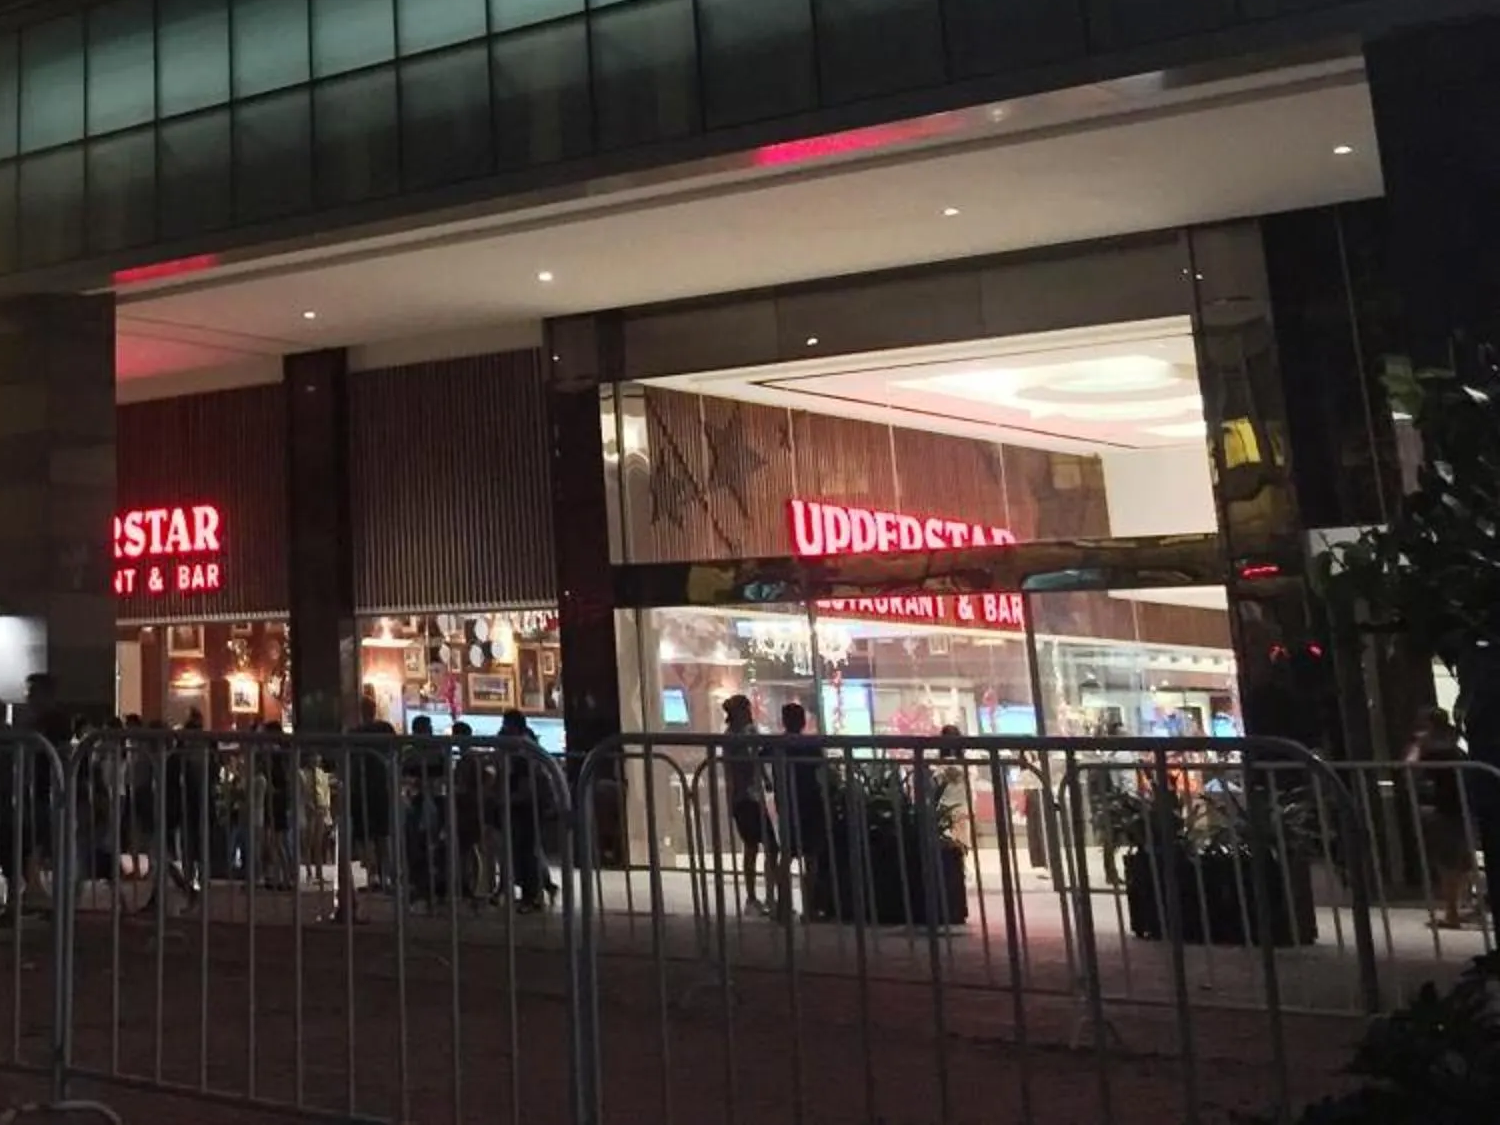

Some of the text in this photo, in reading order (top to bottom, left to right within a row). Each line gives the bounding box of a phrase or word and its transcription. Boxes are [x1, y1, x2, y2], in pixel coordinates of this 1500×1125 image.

[148, 566, 163, 591] &
[178, 563, 219, 590] BAR
[956, 594, 974, 620] &
